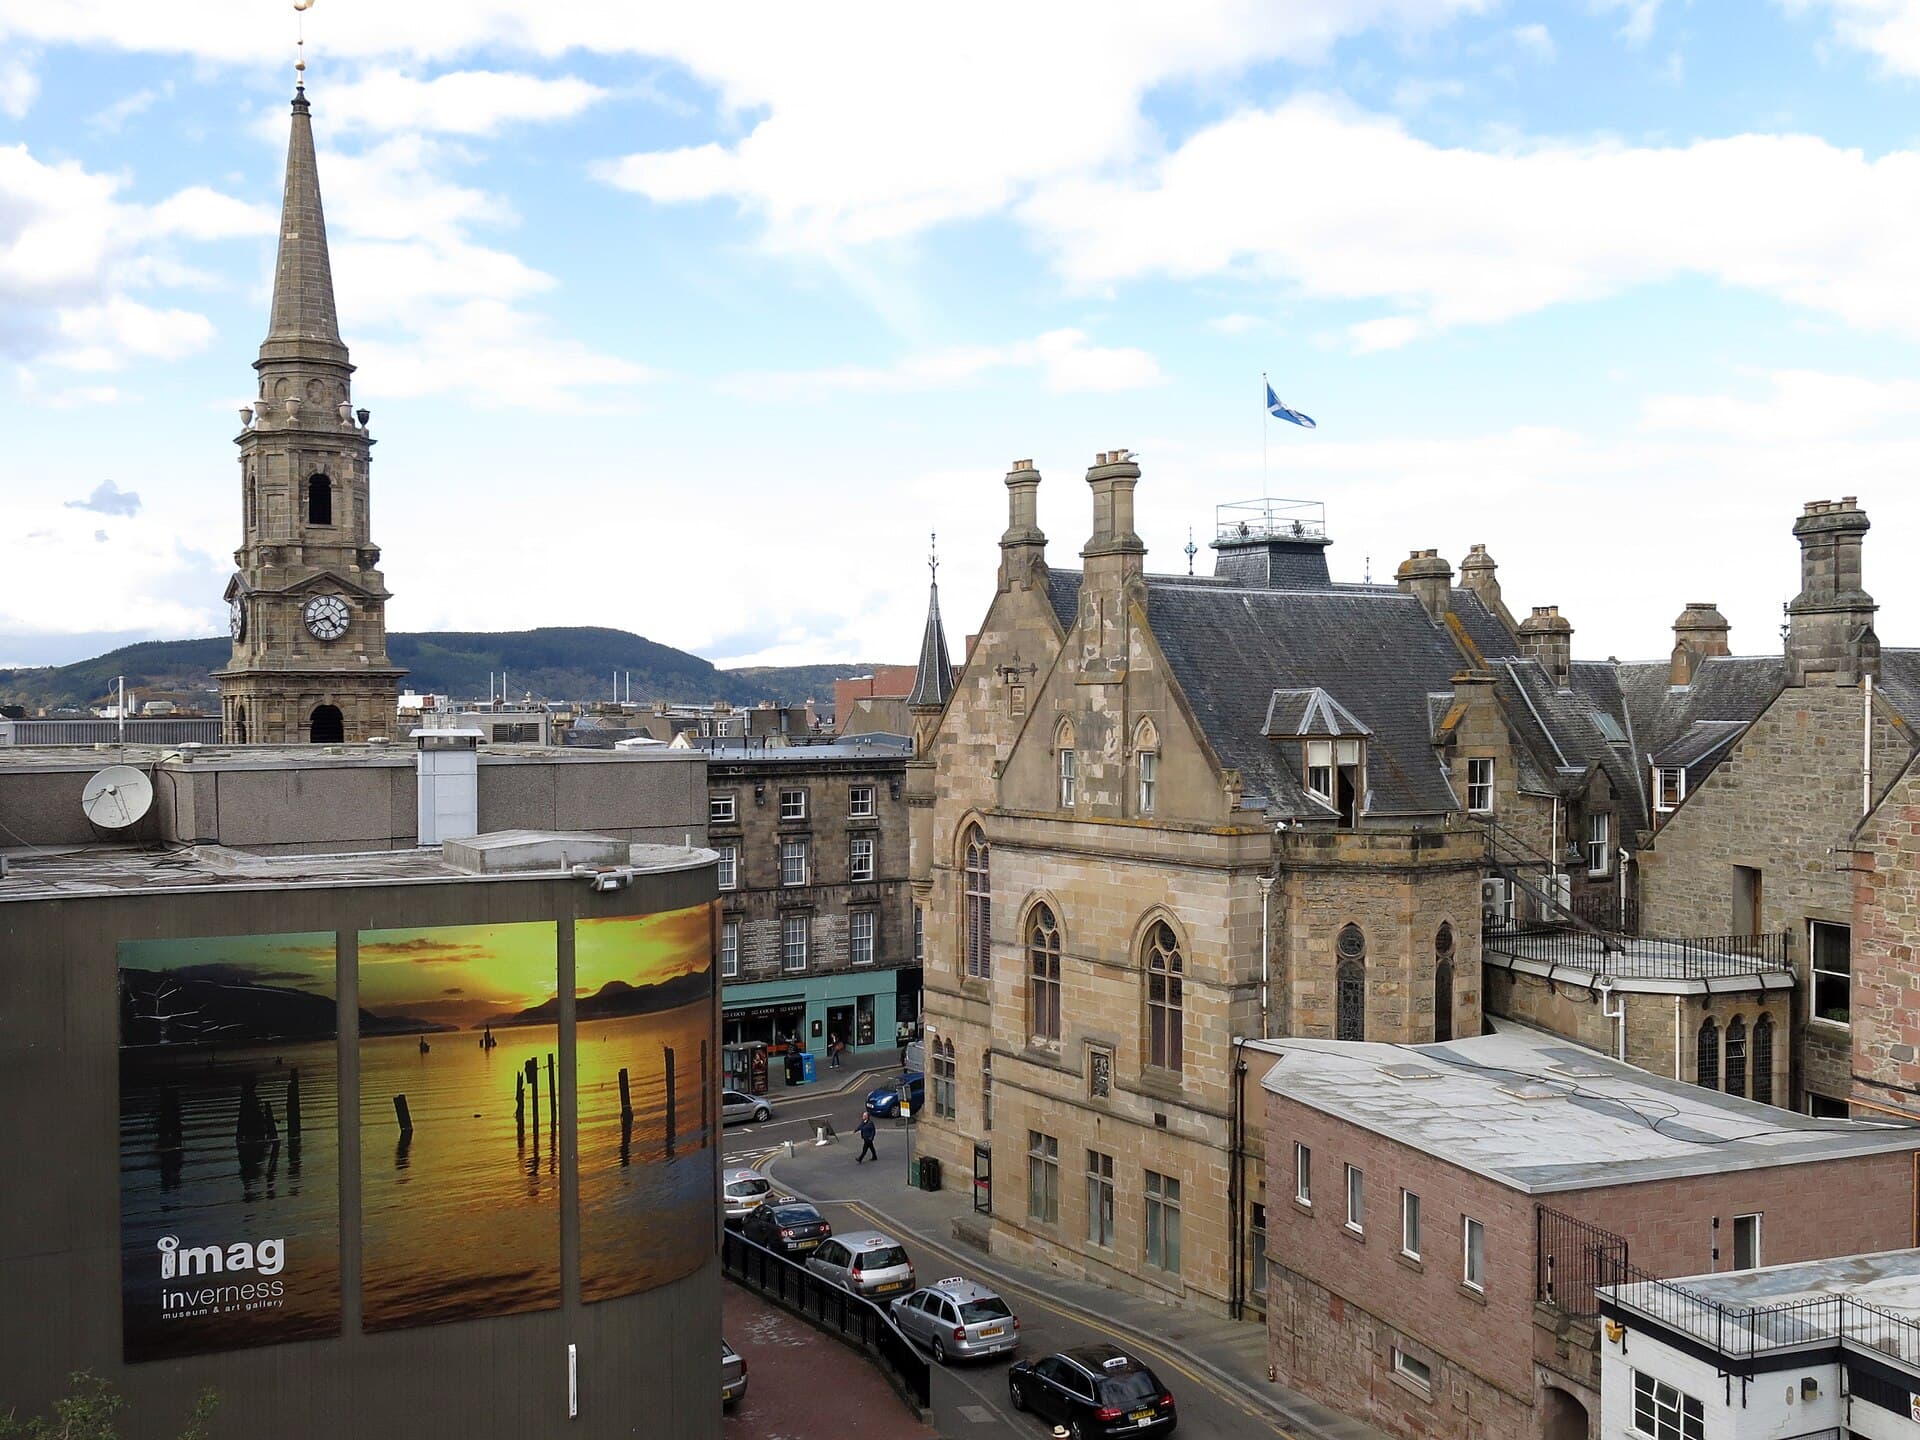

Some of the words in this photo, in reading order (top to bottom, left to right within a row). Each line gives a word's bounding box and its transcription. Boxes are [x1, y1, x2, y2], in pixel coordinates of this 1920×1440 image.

[157, 1234, 285, 1280] imag
[162, 1280, 284, 1310] inverness
[162, 1308, 208, 1319] museum
[213, 1305, 220, 1313] &
[225, 1303, 241, 1312] art
[245, 1299, 284, 1311] gallery
